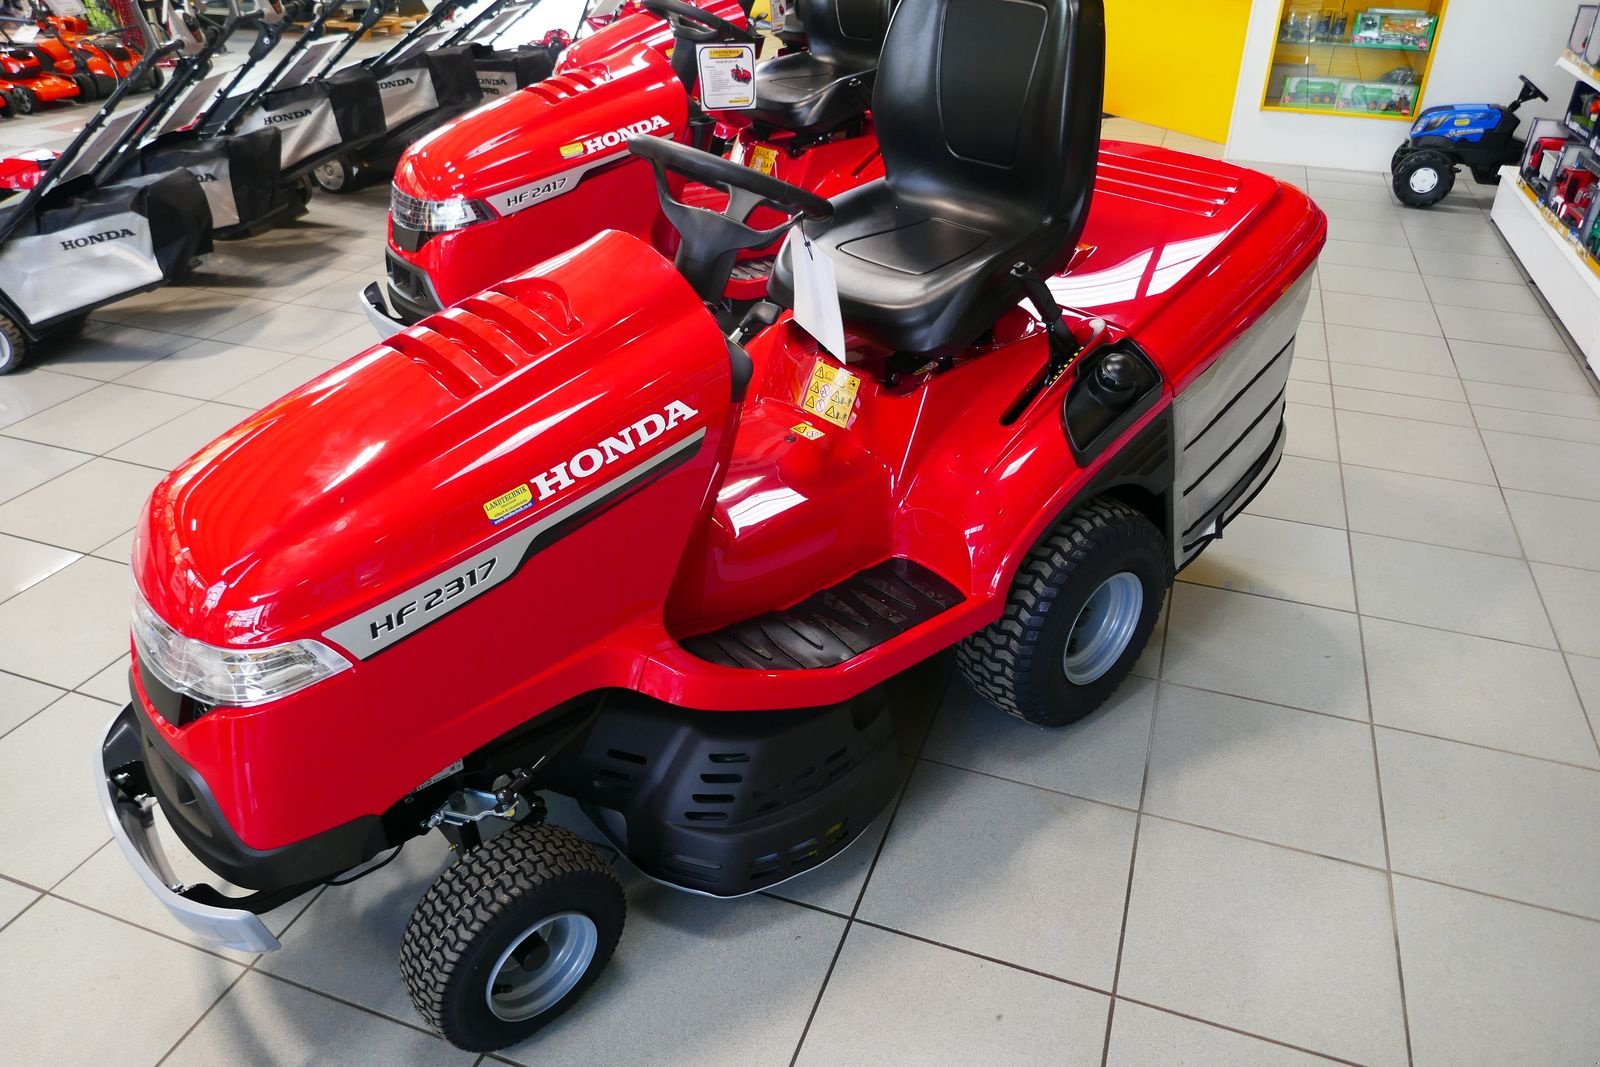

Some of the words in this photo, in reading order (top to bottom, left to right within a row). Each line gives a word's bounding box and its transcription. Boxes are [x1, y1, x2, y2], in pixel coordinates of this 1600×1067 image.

[380, 77, 414, 90] ONDA
[479, 78, 507, 86] ONDA
[264, 109, 312, 125] HONDA
[583, 115, 670, 155] HONDA
[507, 191, 530, 208] HF
[531, 177, 568, 199] 2417
[60, 228, 136, 251] HONDA
[530, 400, 699, 501] HONDA
[485, 485, 527, 512] LANDTECHNIK
[370, 600, 418, 641] HF
[424, 557, 498, 613] 2317
